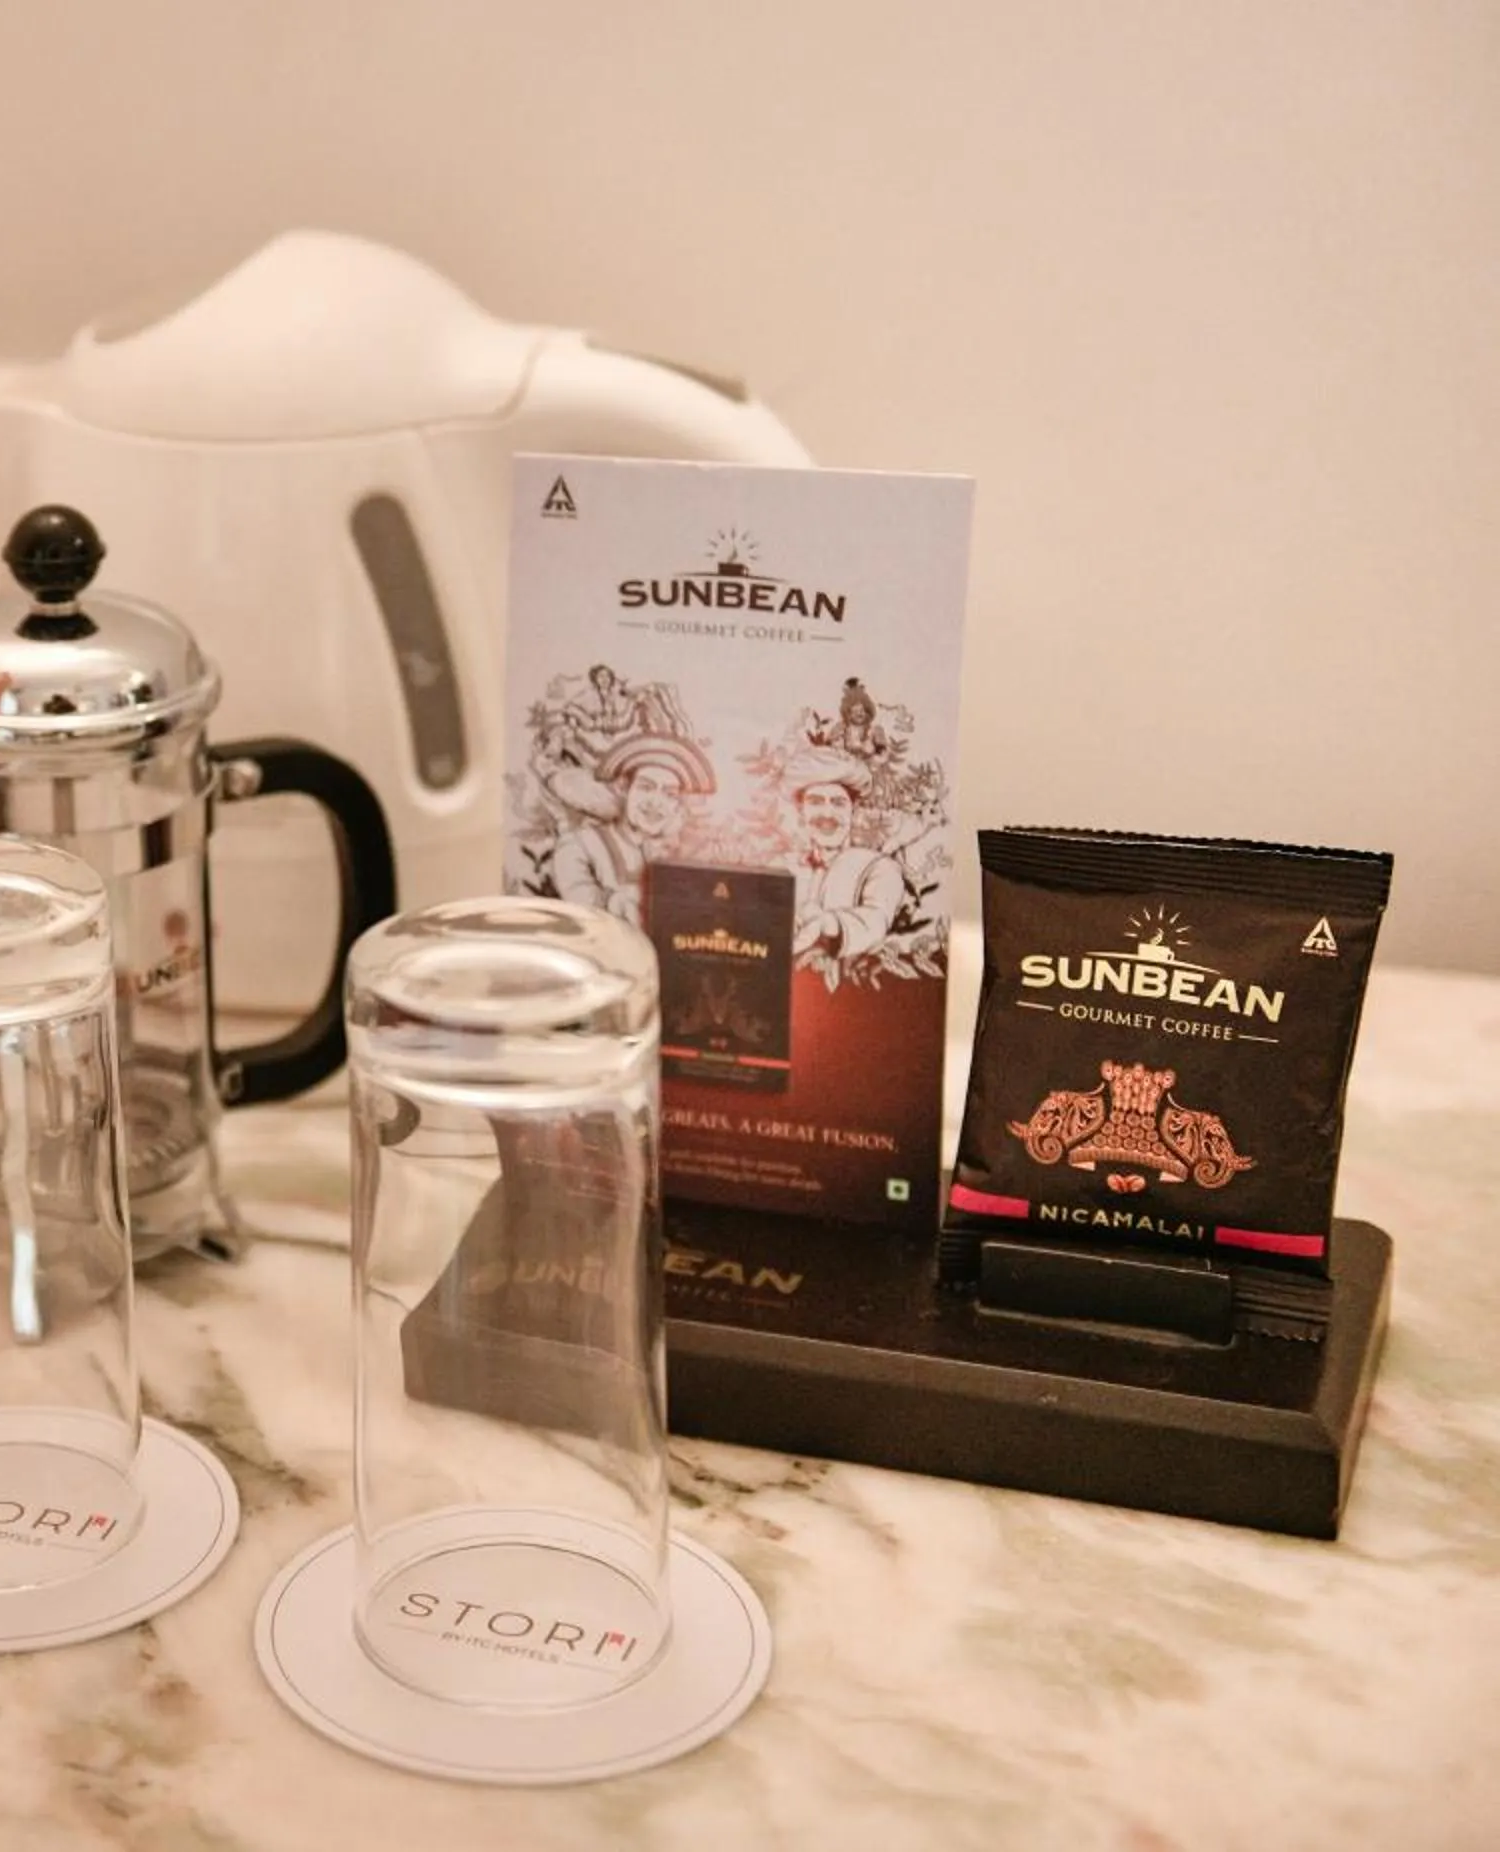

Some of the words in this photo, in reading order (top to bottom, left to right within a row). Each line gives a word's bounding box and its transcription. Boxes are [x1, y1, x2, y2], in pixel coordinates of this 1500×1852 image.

[618, 579, 846, 622] SUNBEAN
[654, 619, 737, 639] GOURMET
[743, 625, 804, 643] COFFEE
[672, 934, 769, 959] SUNBEAN
[1020, 954, 1285, 1023] SUNBEAN
[1058, 1002, 1156, 1030] GOURMET
[1161, 1017, 1234, 1041] COFFEE
[739, 1117, 752, 1134] A
[756, 1118, 817, 1144] GREAT
[1039, 1203, 1204, 1241] NICAMALAI
